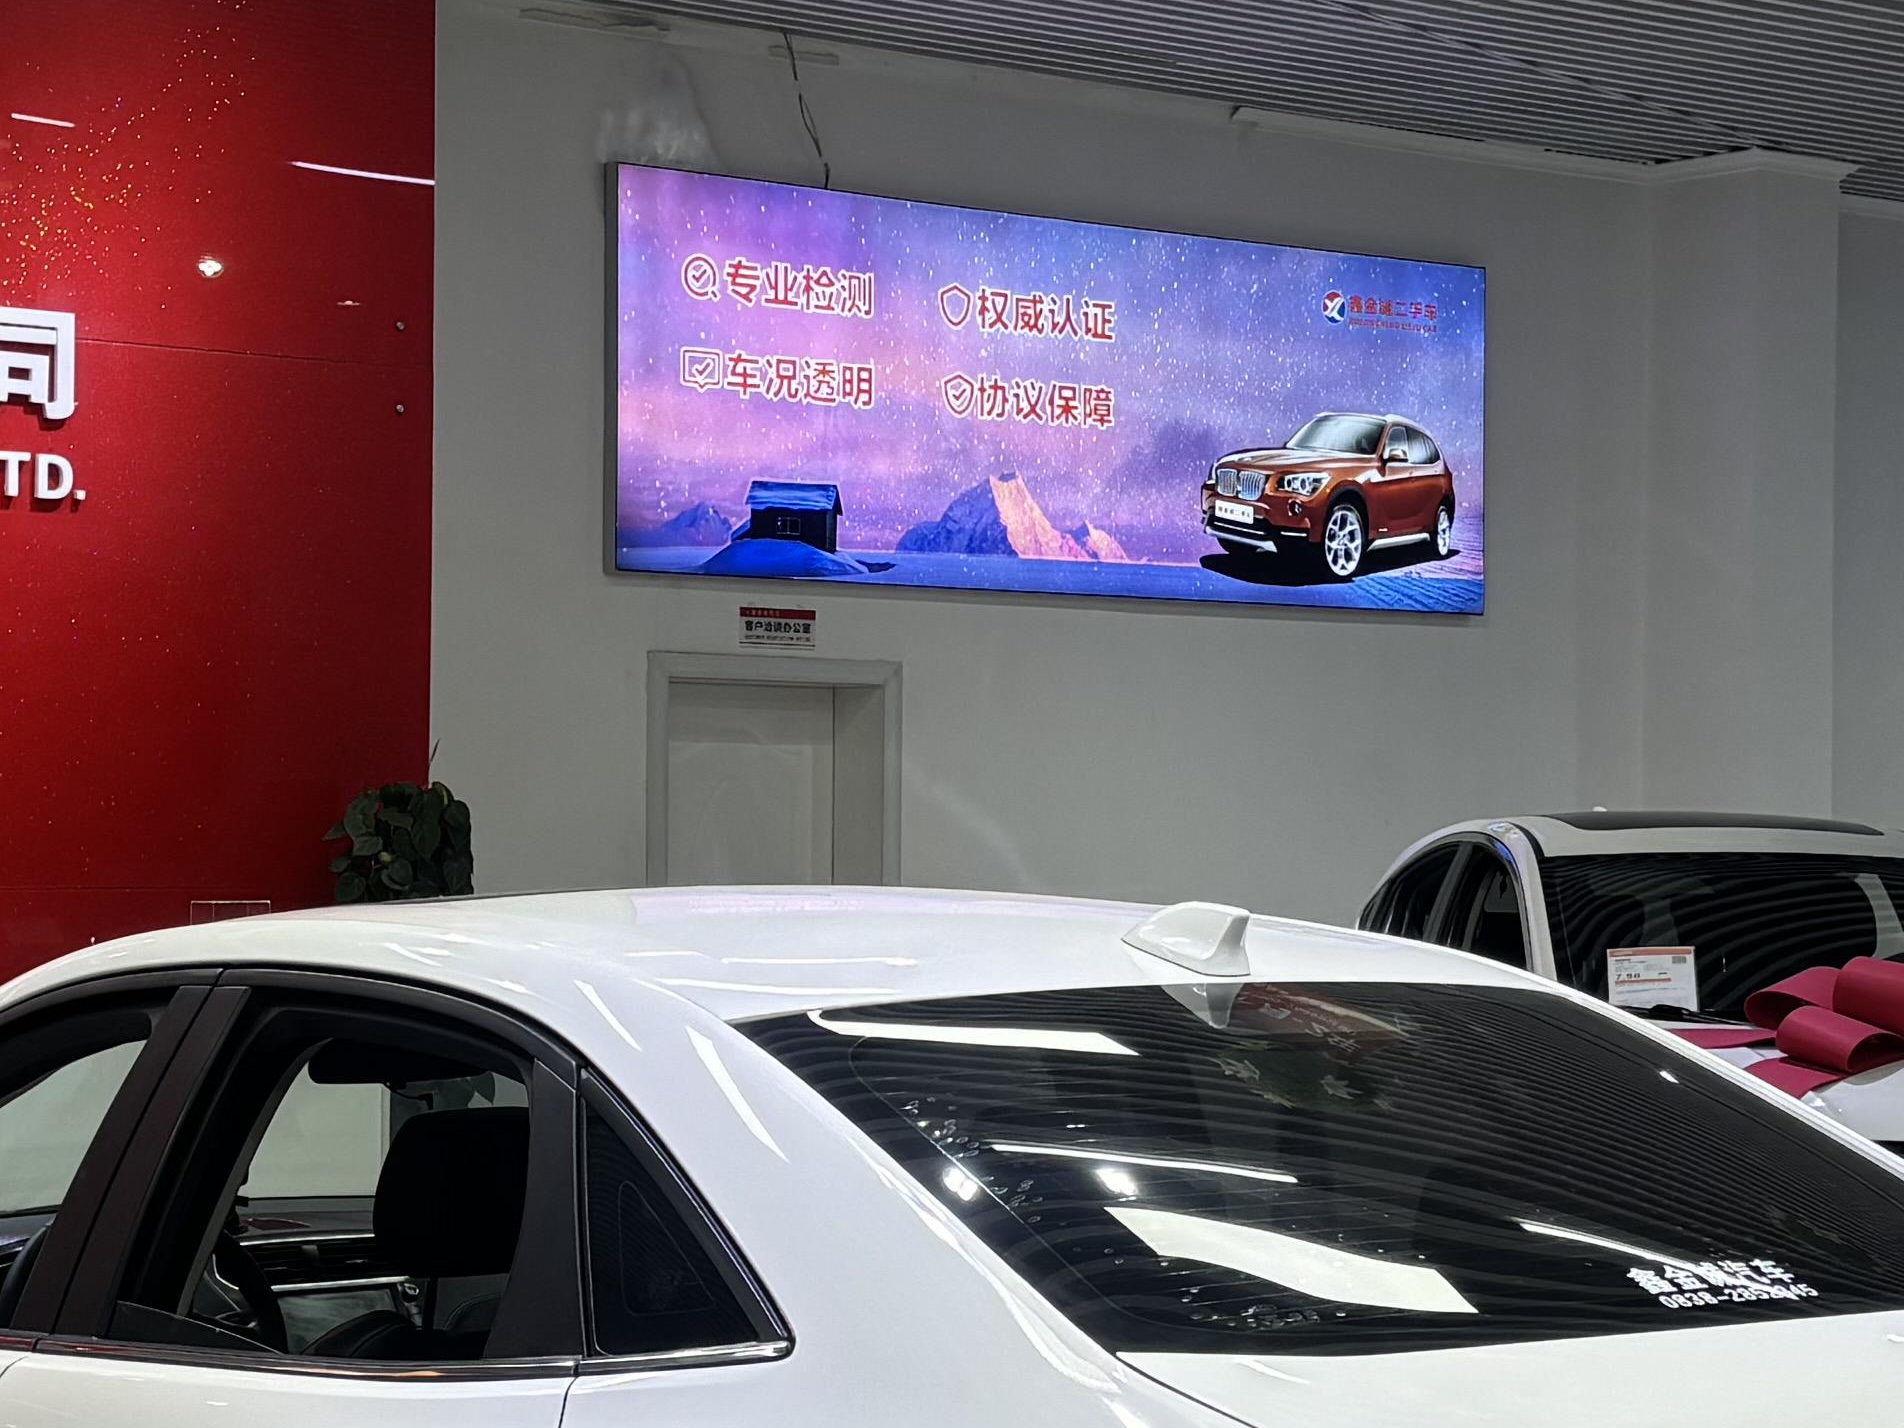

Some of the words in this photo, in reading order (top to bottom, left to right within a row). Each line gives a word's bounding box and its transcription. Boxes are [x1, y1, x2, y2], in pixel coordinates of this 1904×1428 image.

[725, 256, 876, 318] 专业检测
[977, 288, 1116, 343] 权威认证
[725, 351, 876, 409] 车况透明
[977, 381, 1116, 429] 协议保障
